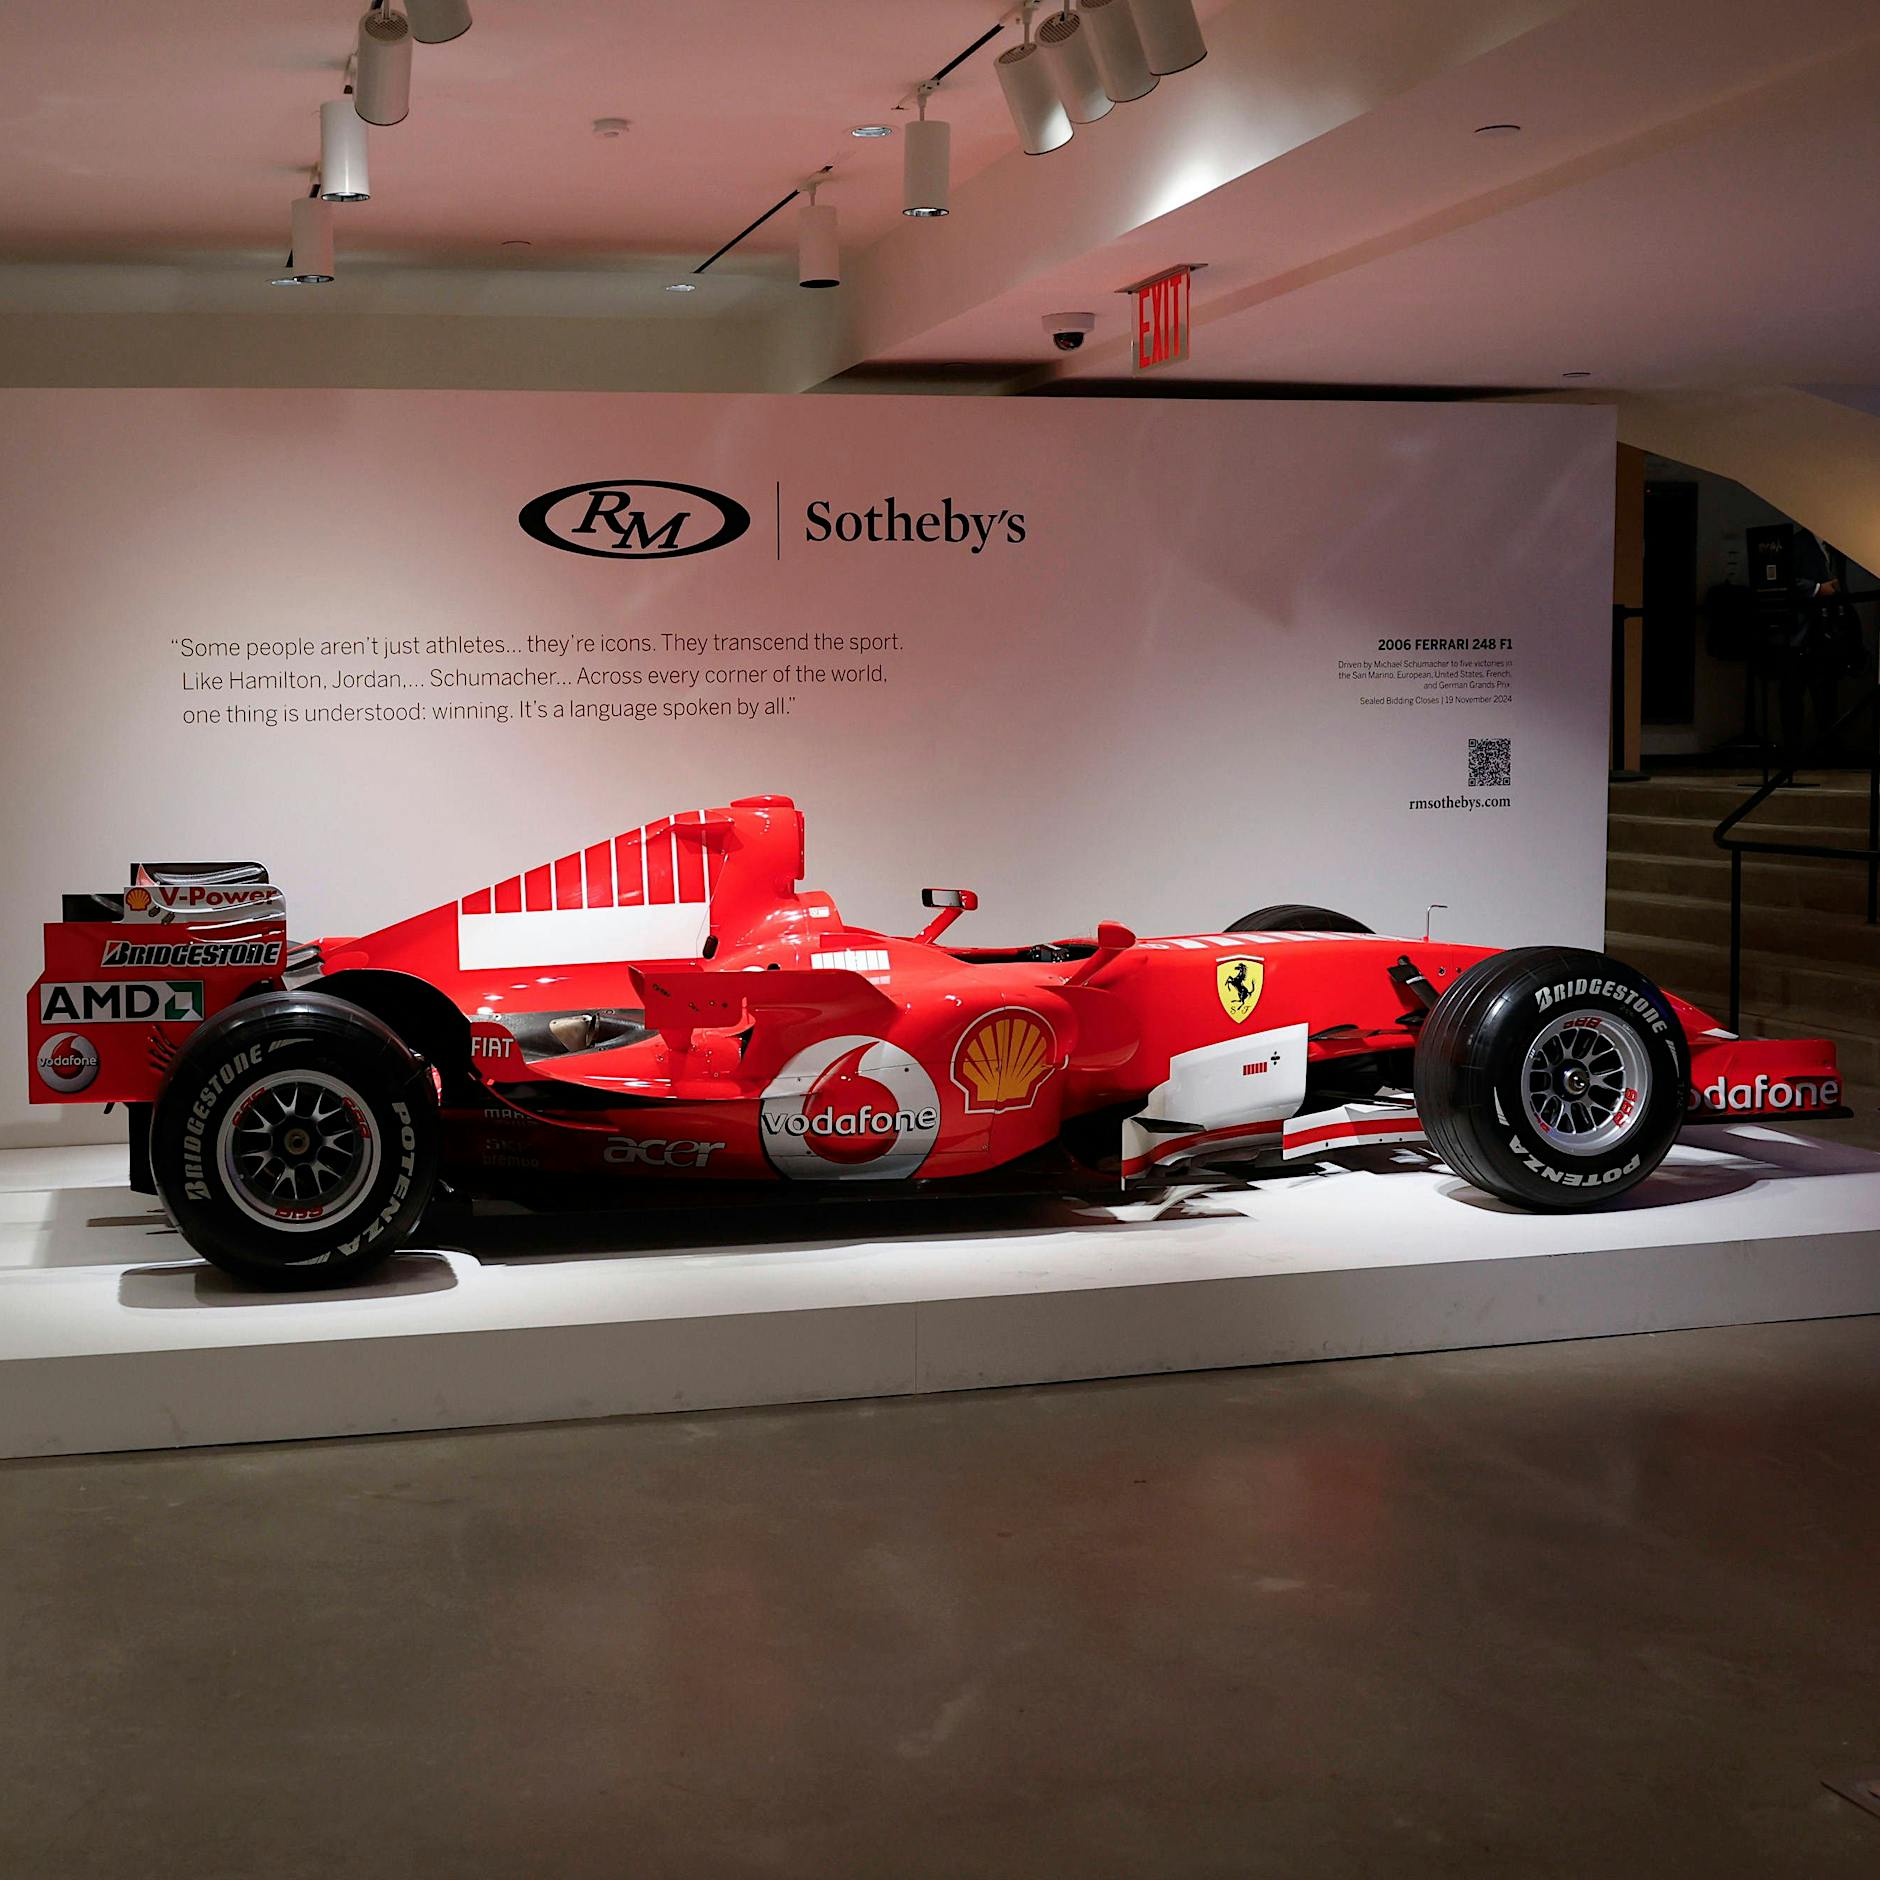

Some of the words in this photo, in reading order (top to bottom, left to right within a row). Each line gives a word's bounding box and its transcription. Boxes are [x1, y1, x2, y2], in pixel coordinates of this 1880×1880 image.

[1139, 272, 1182, 369] EXIT
[571, 490, 691, 550] RM
[805, 496, 1026, 554] Sotheby’s
[171, 637, 240, 657] “Some
[246, 637, 315, 660] people
[320, 636, 381, 656] aren’t
[383, 636, 420, 659] just
[425, 634, 523, 655] athletes...
[527, 633, 595, 658] they’re
[600, 633, 656, 652] icons.
[661, 633, 708, 655] They
[713, 632, 809, 652] transcend
[814, 632, 845, 650] the
[849, 632, 903, 655] sport.
[1378, 638, 1411, 651] 2006
[1415, 638, 1469, 651] FERRARI
[1472, 638, 1496, 650] 248
[1500, 638, 1513, 650] F1
[183, 671, 223, 691] Like
[229, 670, 328, 693] Hamilton,
[430, 666, 572, 687] Schumacher...
[576, 666, 643, 686] Across
[648, 667, 700, 688] every
[704, 666, 767, 685] corner
[773, 665, 791, 683] of
[796, 665, 826, 683] the
[831, 664, 888, 686] world,
[1338, 660, 1362, 669] Driven
[1363, 660, 1373, 670] by
[1373, 660, 1402, 669] Michael
[1403, 659, 1449, 668] Schumacher
[1450, 659, 1459, 668] to
[1459, 659, 1473, 668] five
[1474, 659, 1505, 668] victories
[1505, 660, 1513, 668] in
[1338, 671, 1351, 680] the
[1352, 671, 1367, 680] San
[1396, 670, 1433, 681] European,
[1434, 670, 1459, 679] United
[1460, 670, 1484, 679] States,
[1486, 669, 1512, 679] French,
[1423, 682, 1437, 690] and
[1438, 681, 1468, 690] German
[1469, 680, 1495, 689] Grands
[183, 707, 221, 725] one
[226, 704, 278, 727] thing
[284, 703, 300, 723] is
[305, 701, 426, 723] understood:
[432, 701, 514, 723] winning.
[520, 699, 548, 719] It’s
[553, 703, 564, 719] a
[569, 699, 658, 722] language
[663, 697, 731, 720] spoken
[737, 697, 759, 720] by
[764, 696, 796, 715] all.”
[1359, 696, 1385, 706] Sealed
[1386, 696, 1414, 707] Bidding
[1415, 695, 1440, 705] Closes
[1445, 695, 1454, 704] 19
[1455, 695, 1492, 704] November
[1493, 694, 1513, 704] 2024
[1409, 794, 1511, 812] rmsothebys.com
[158, 886, 281, 907] V-Power
[100, 940, 283, 968] BRIDGESTONE
[42, 984, 160, 1021] AMD
[1534, 977, 1668, 1034] BRIDGESTONE
[38, 1053, 97, 1068] vodafone
[470, 1036, 515, 1058] FIAT
[1687, 1074, 1839, 1111] odafone
[183, 1041, 265, 1202] BRIDGESTONE
[761, 1105, 938, 1137] vodafone
[603, 1136, 726, 1168] acer
[1508, 1134, 1642, 1187] POTENZA
[336, 1101, 416, 1257] POTENZA
